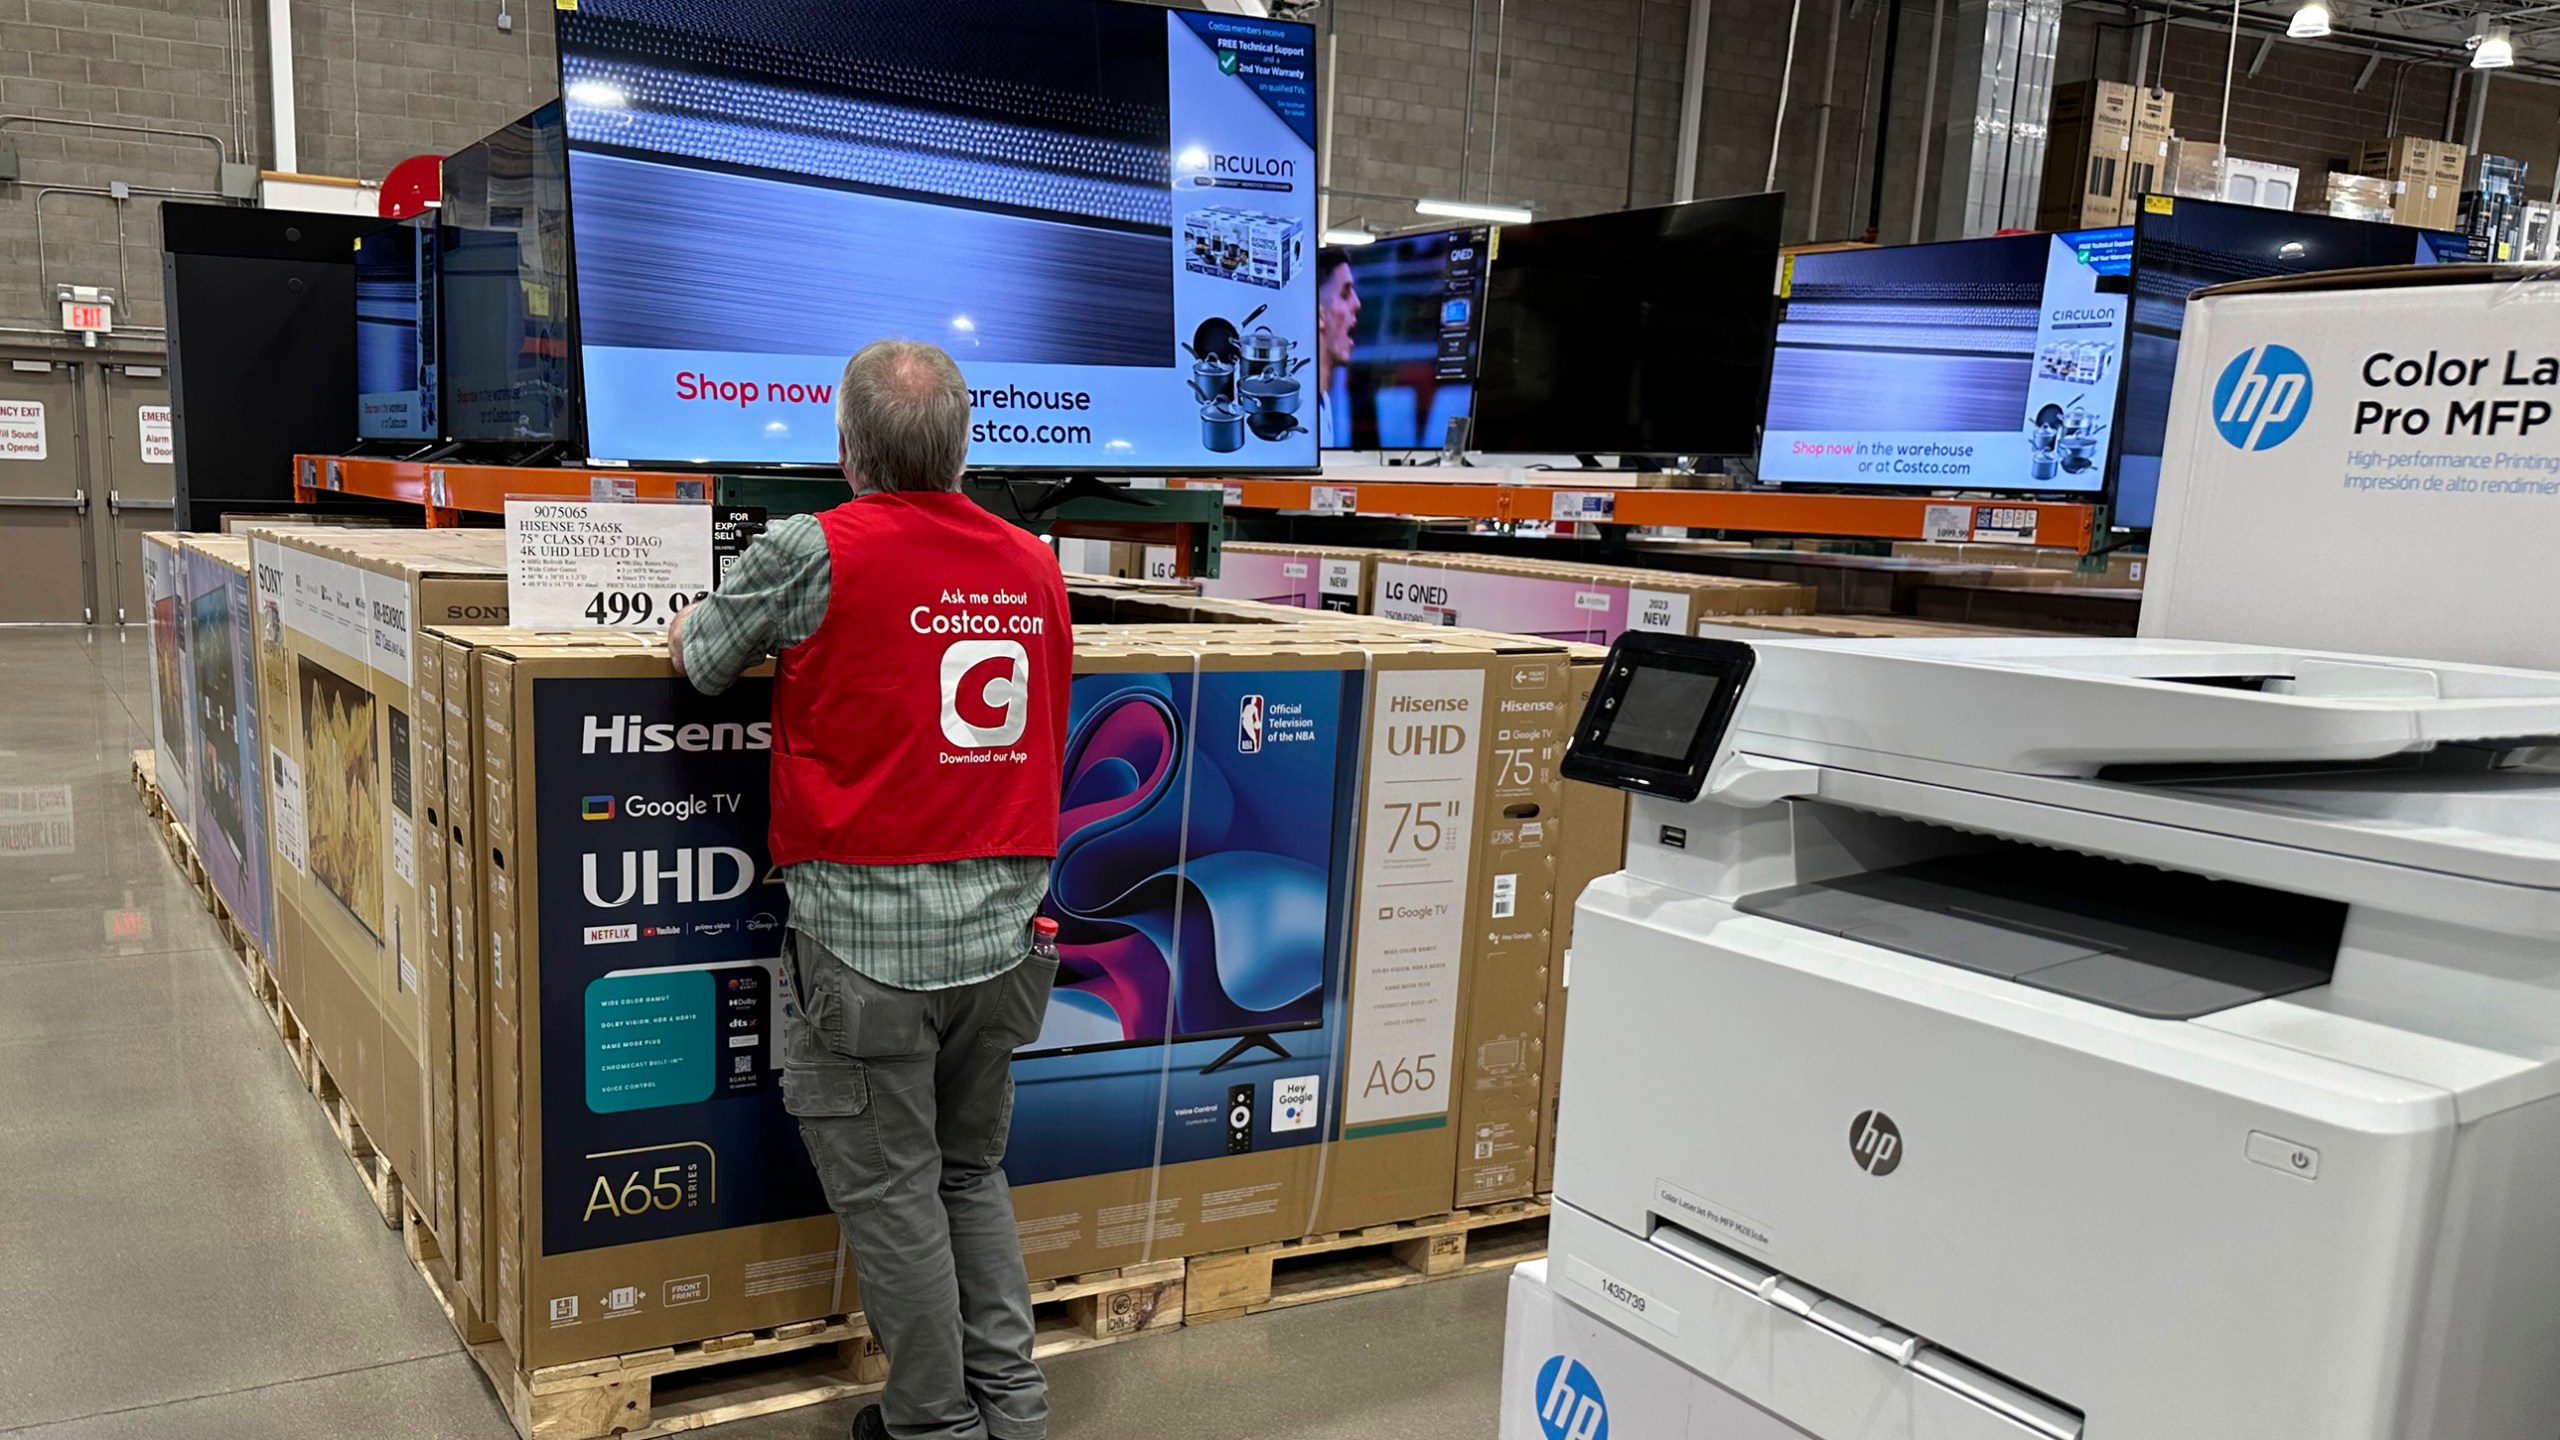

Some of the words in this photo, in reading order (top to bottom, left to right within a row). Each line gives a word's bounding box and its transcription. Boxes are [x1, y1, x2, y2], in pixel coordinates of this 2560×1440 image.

[1208, 21, 1230, 32] Costco
[1232, 25, 1260, 36] members
[1262, 28, 1285, 39] receive
[1218, 38, 1238, 50] FREE
[1239, 40, 1273, 54] Technical
[1274, 44, 1304, 58] Support
[1263, 55, 1274, 64] and
[1239, 63, 1254, 74] 2nd
[1254, 65, 1271, 76] Year
[1272, 67, 1304, 80] Warranty
[1268, 83, 1293, 94] qualified
[1194, 153, 1294, 177] IRCULON
[73, 305, 102, 328] EXIT
[2052, 308, 2115, 322] CIRCULON
[2362, 350, 2490, 387] Color
[2503, 350, 2560, 386] La
[676, 372, 758, 408] Shop
[768, 384, 832, 404] now
[968, 384, 1090, 410] arehouse
[2217, 345, 2309, 451] hp
[21, 408, 41, 418] EXIT
[2353, 400, 2430, 436] Pro
[2446, 400, 2551, 436] MFP
[12, 429, 38, 439] Sound
[146, 434, 170, 443] Alarm
[972, 420, 1091, 444] stco.com
[7, 443, 40, 454] Opened
[1792, 441, 1824, 458] Shop
[1826, 444, 1854, 455] now
[1856, 442, 1868, 454] in
[1871, 442, 1894, 455] the
[1896, 443, 1974, 458] warehouse
[1858, 463, 1873, 474] or
[1875, 462, 1890, 474] at
[1893, 460, 1970, 475] Costco.com
[2347, 451, 2490, 470] High-performance
[2344, 474, 2420, 492] Impresión
[2423, 476, 2444, 490] de
[2446, 476, 2478, 492] alto
[534, 506, 588, 519] 9075065
[730, 512, 749, 521] FOR
[520, 521, 575, 532] HISENSE
[578, 522, 623, 534] 75A65K
[520, 534, 538, 545] 75"
[543, 535, 584, 546] CLASS
[626, 536, 662, 548] DIAG)
[520, 546, 536, 556] 4K
[540, 547, 570, 558] UHD
[574, 548, 600, 558] LED
[604, 548, 630, 558] LCD
[634, 549, 651, 559] TV
[1152, 562, 1165, 578] LG
[1329, 576, 1348, 588] NEW
[940, 588, 966, 604] Ask
[969, 593, 989, 605] me
[993, 588, 1028, 605] about
[1386, 581, 1404, 600] LG
[1408, 584, 1448, 606] QNED
[1649, 599, 1668, 610] 2023
[1643, 612, 1670, 626] NEW
[1270, 704, 1302, 716] Official
[1390, 696, 1469, 713] Hisense
[1501, 700, 1554, 713] Hisense
[1268, 717, 1314, 729] Television
[582, 715, 772, 754] Hisens
[1268, 732, 1276, 742] of
[1278, 732, 1294, 742] the
[1296, 731, 1316, 742] NBA
[1388, 724, 1466, 756] UHD
[1512, 730, 1540, 742] Google
[1542, 730, 1552, 738] TV
[940, 752, 990, 764] Download
[993, 752, 1008, 762] our
[1010, 750, 1027, 763] App
[625, 794, 707, 822] Google
[712, 794, 742, 813] TV
[582, 846, 755, 908] UHD
[1397, 906, 1433, 920] Google
[1435, 904, 1448, 916] TV
[656, 926, 680, 936] YouTube
[694, 923, 712, 932] prime
[714, 922, 731, 930] video
[591, 928, 630, 942] NETFLIX
[621, 998, 644, 1006] COLOR
[738, 998, 756, 1006] Dolby
[729, 1019, 748, 1028] dts
[601, 1042, 621, 1050] GAME
[644, 1038, 661, 1046] PLUS
[602, 1061, 648, 1072] CHROMECAST
[1363, 1054, 1436, 1098] A65
[624, 1082, 656, 1090] CONTROL
[1287, 1084, 1306, 1094] Hey
[1279, 1092, 1313, 1105] Google
[1174, 1108, 1193, 1116] Voice
[1194, 1104, 1218, 1114] Control
[1851, 1110, 1902, 1176] hp
[688, 1162, 698, 1208] SERIES
[582, 1166, 682, 1222] A65
[1660, 1190, 1678, 1204] Color
[1707, 1210, 1718, 1222] Pro
[1720, 1216, 1734, 1228] MFP
[672, 1282, 702, 1294] FRONT
[672, 1289, 701, 1301] FRENTE
[1601, 1278, 1646, 1312] 1435739
